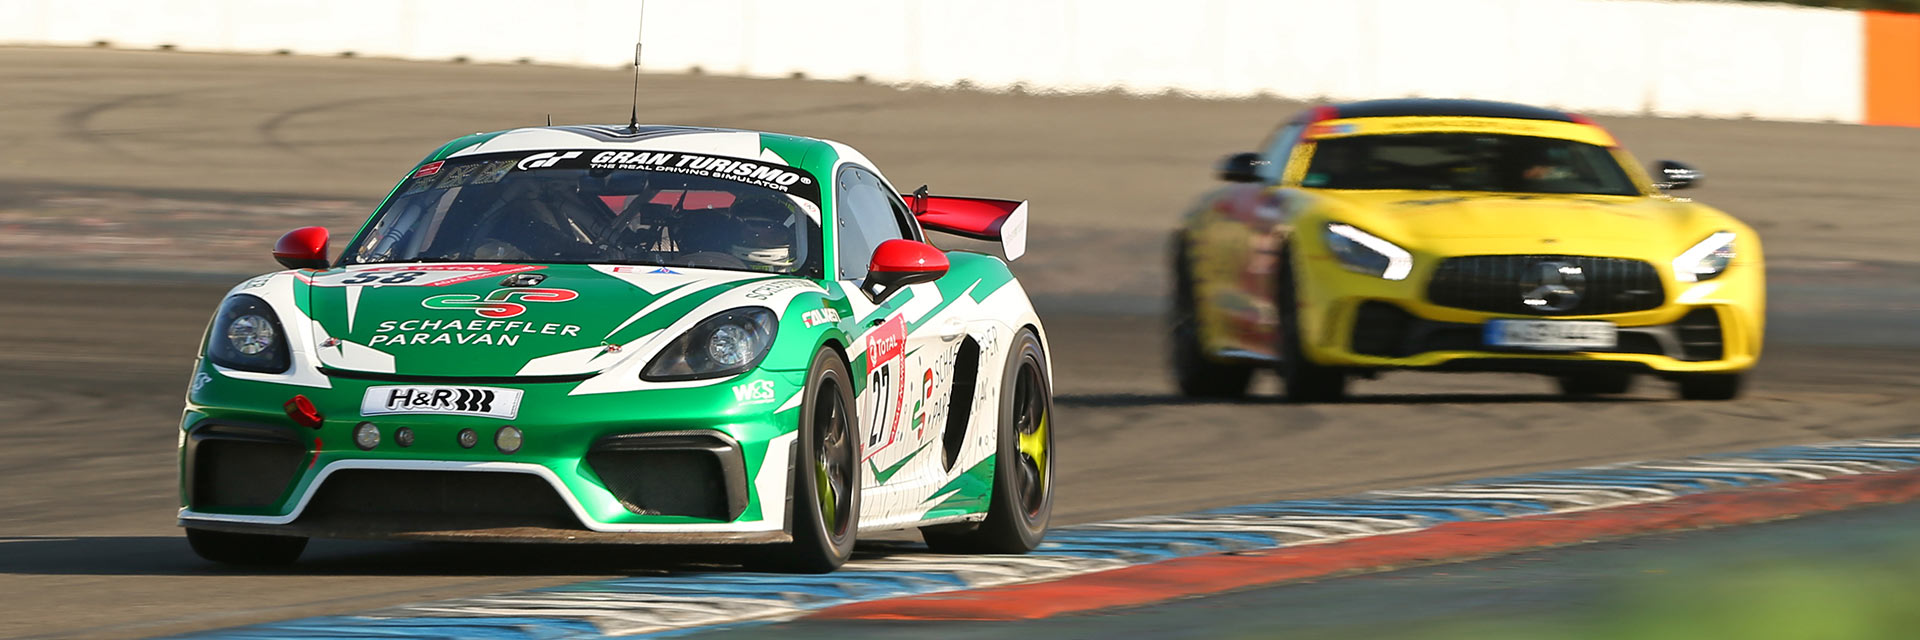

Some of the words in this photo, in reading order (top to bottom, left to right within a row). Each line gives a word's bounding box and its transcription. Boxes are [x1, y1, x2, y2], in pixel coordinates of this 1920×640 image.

[591, 151, 674, 166] GRAN
[655, 165, 709, 176] DRIVING
[712, 172, 789, 192] SIMULATOR
[342, 271, 427, 284] 58
[376, 319, 581, 337] SCHAEFFLER
[368, 332, 520, 346] PARAVAN
[877, 336, 898, 356] TOTAL
[388, 389, 453, 408] H&R
[732, 379, 775, 401] W&S
[871, 363, 889, 448] 27
